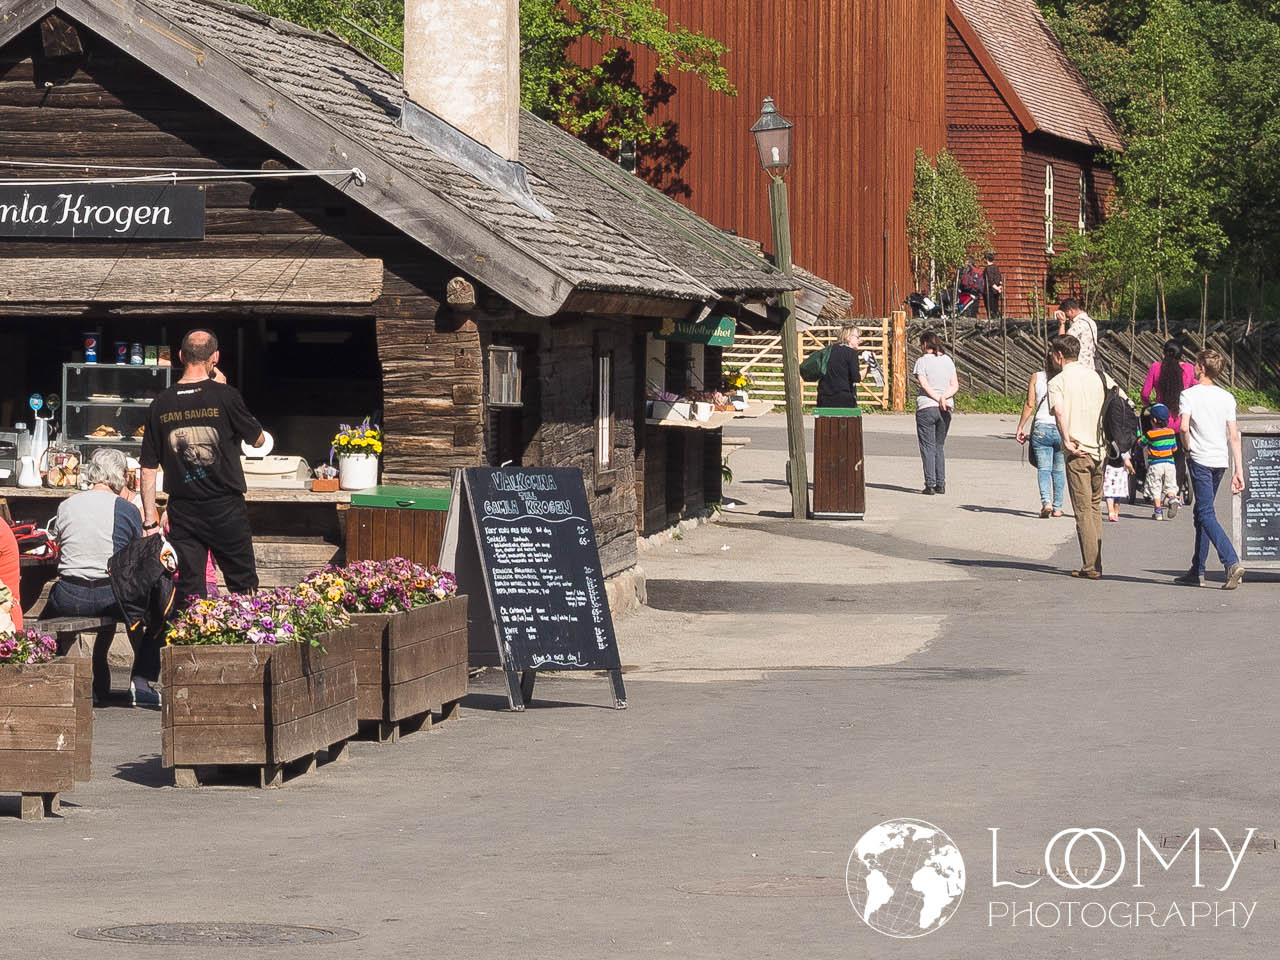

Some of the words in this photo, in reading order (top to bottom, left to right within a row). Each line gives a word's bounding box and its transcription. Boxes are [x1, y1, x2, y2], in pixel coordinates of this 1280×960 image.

[56, 193, 172, 233] Krogen
[160, 412, 183, 424] TEAM
[184, 408, 220, 420] SAVAGE
[518, 491, 537, 500] TILL
[483, 500, 519, 515] GAMLA
[525, 500, 573, 515] KROGEN
